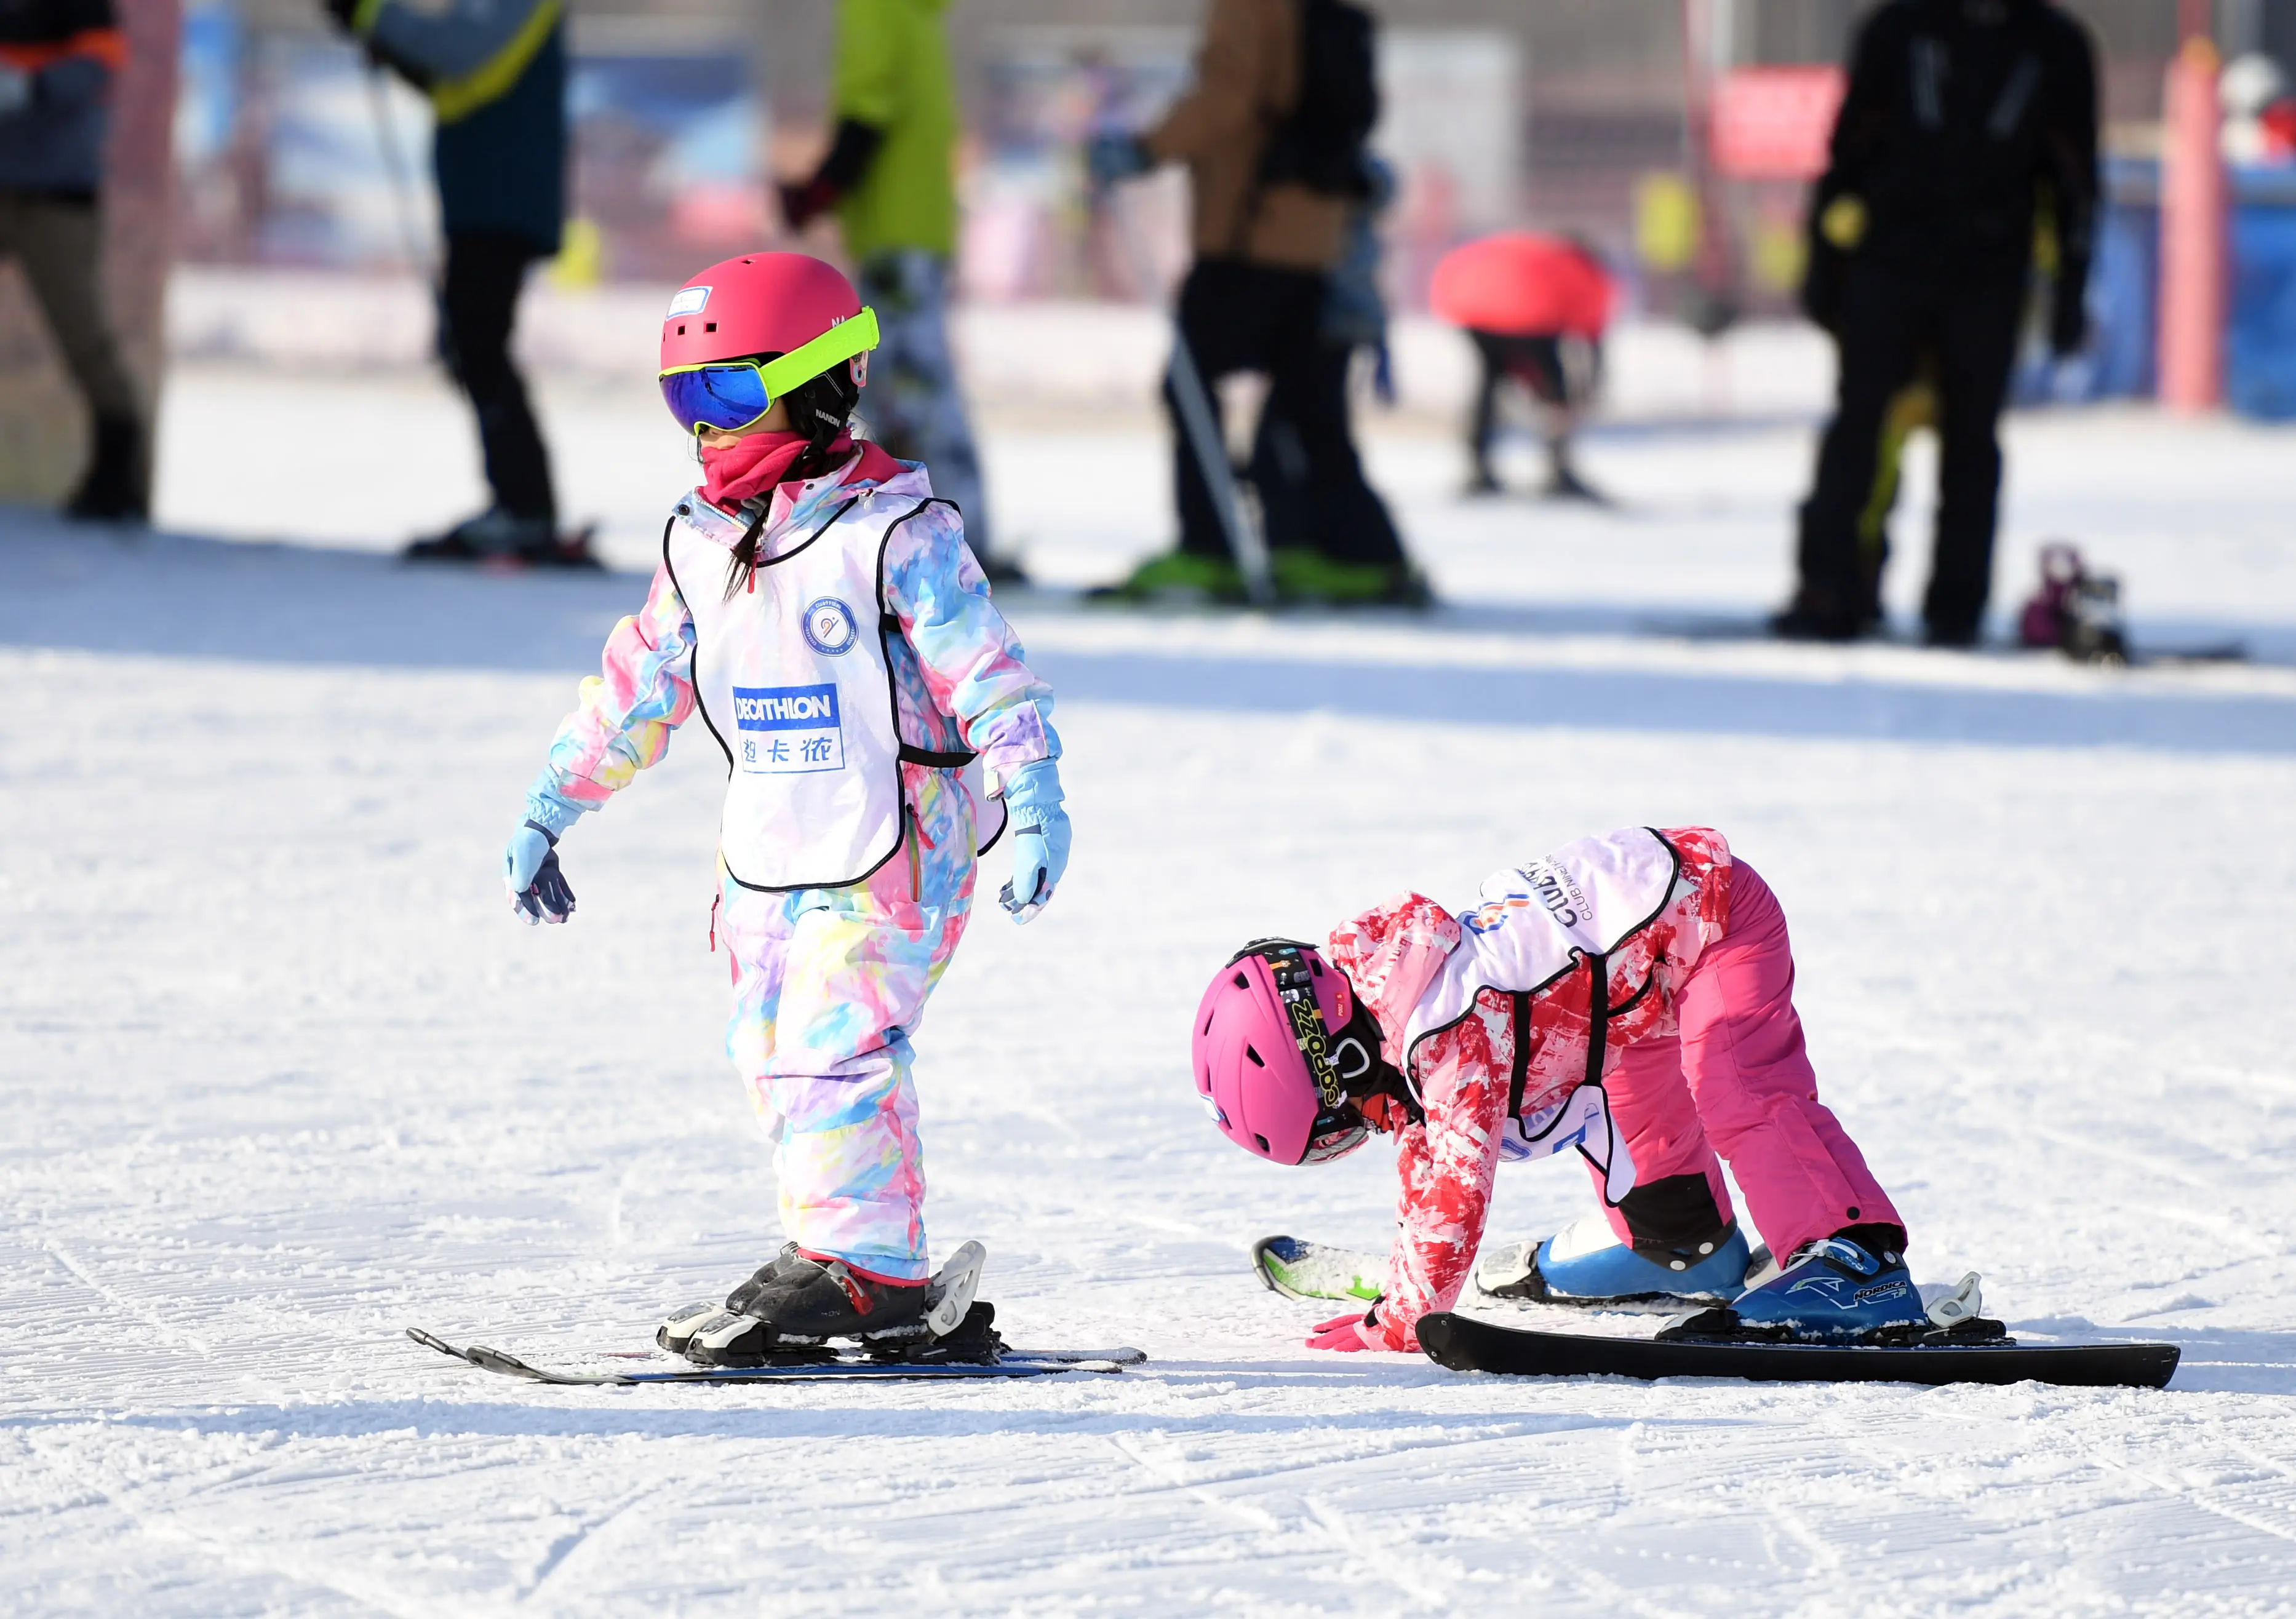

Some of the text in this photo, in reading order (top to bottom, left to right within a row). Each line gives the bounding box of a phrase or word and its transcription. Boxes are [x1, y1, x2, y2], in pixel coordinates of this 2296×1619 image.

[735, 694, 831, 720] DECATHLON
[1569, 888, 1593, 921] CLUB
[1853, 1281, 1907, 1302] NORDICA
